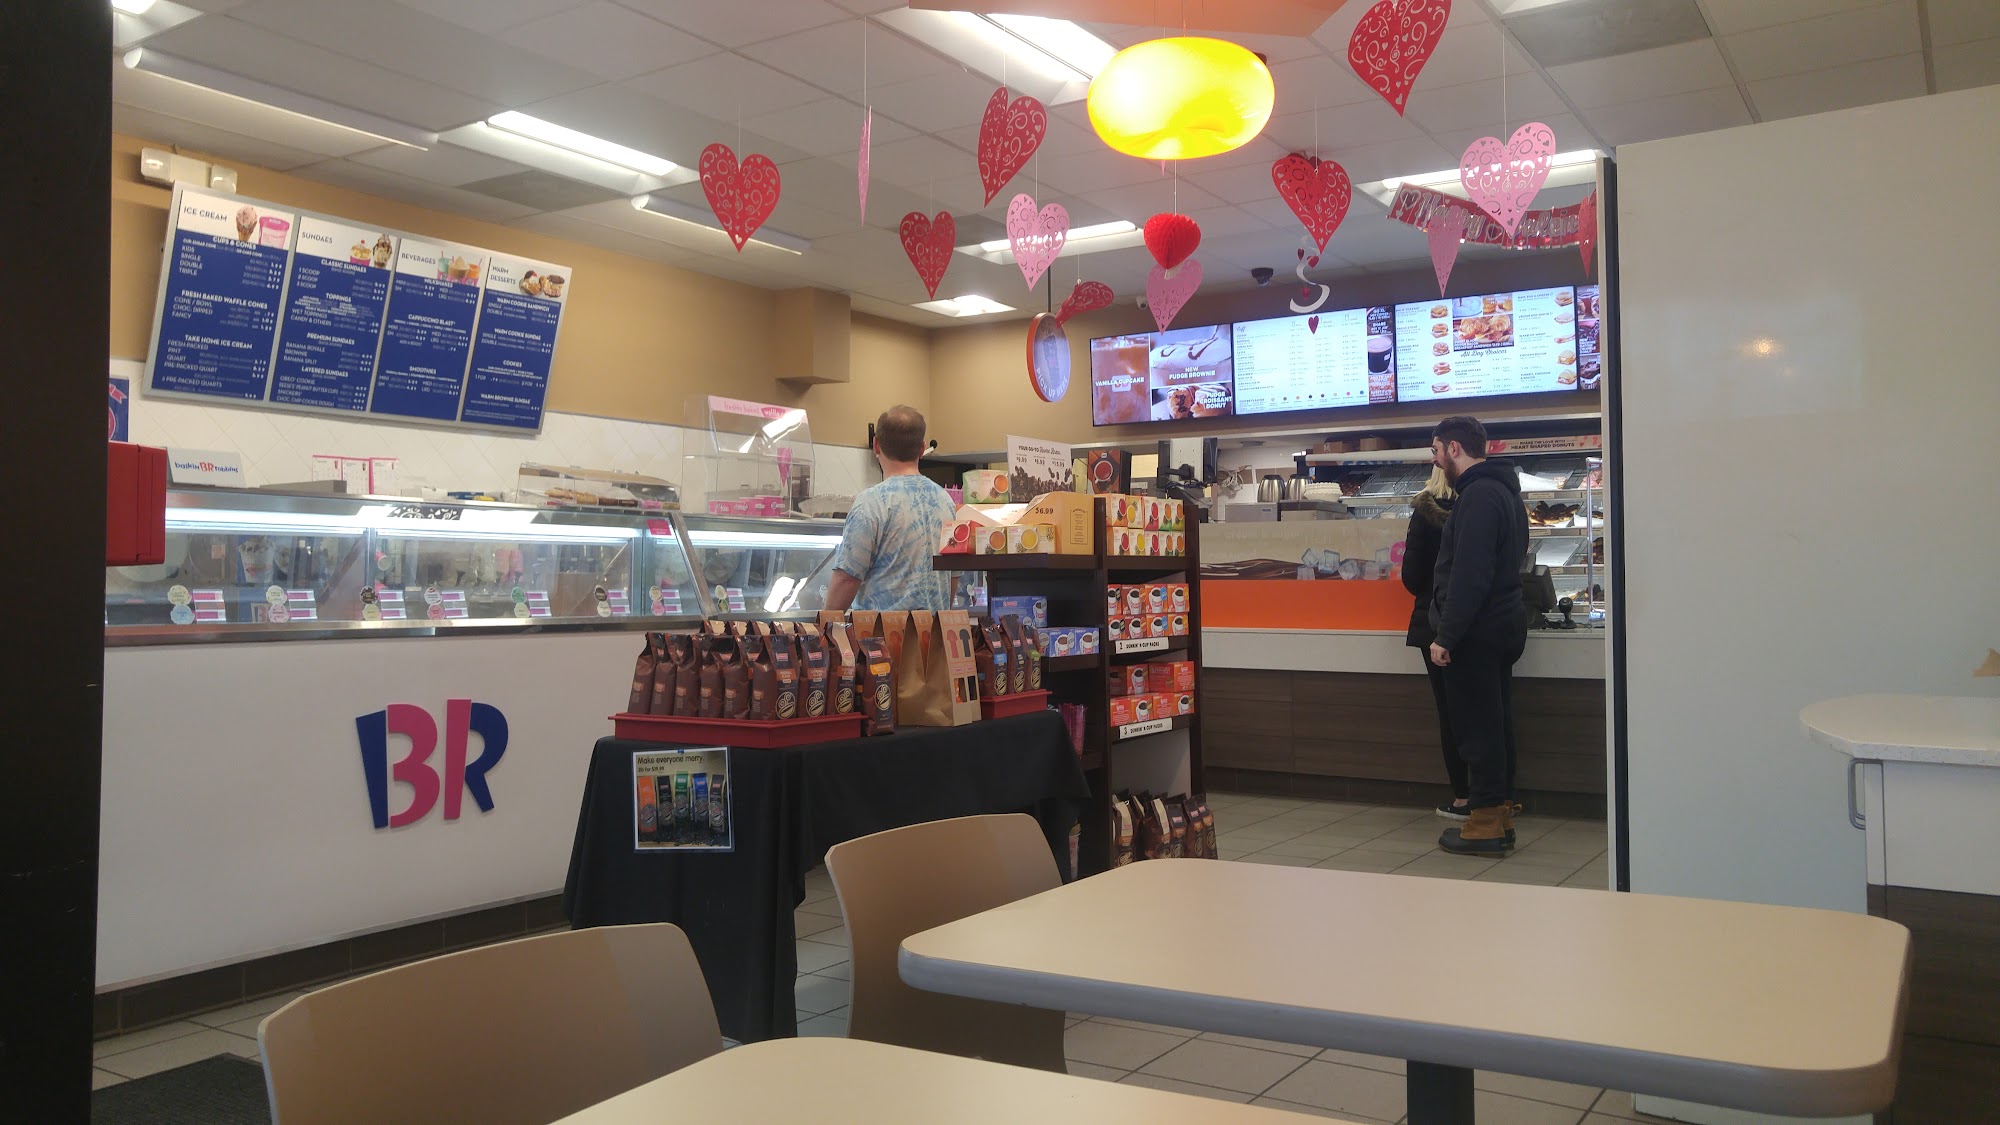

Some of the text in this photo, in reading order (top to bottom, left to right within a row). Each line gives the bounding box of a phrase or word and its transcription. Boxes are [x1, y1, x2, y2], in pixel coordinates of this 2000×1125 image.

[184, 206, 227, 221] ICE CREAM
[302, 232, 332, 244] SUNDAES
[213, 236, 229, 244] CUPS
[236, 241, 256, 250] CONES
[181, 252, 201, 261] SINGLE
[402, 253, 436, 264] BEVERAGES
[180, 260, 202, 269] DOUBLE
[321, 259, 343, 268] CLASSIC
[344, 262, 366, 273] SUNDAES
[179, 267, 197, 276] TRIPLE
[302, 267, 320, 276] SCOOP
[492, 266, 509, 274] WARM
[302, 274, 318, 282] SCOOP
[491, 275, 516, 284] DESSERTS
[424, 279, 453, 288] MILKSHAKES
[182, 289, 268, 309] FRESH BAKED WAFFLE CONES
[326, 293, 351, 302] TOPPINGS
[497, 297, 550, 312] WARM COOKIE SANDWICH
[172, 311, 191, 319] FANCY
[408, 314, 440, 324] CAPPUCCINO
[313, 318, 331, 326] OTHERS
[307, 332, 331, 341] PREMIUM
[332, 336, 355, 345] SUNDAES
[508, 329, 524, 337] COOKIE
[525, 332, 541, 340] SUNDAE
[185, 334, 200, 342] TAKE
[201, 337, 220, 345] HOME
[232, 341, 253, 350] CREAM
[1472, 349, 1484, 357] Day
[302, 366, 325, 374] LAYERED
[326, 369, 348, 377] SUNDAES
[409, 366, 436, 374] SMOOTHIES
[1037, 368, 1048, 393] PICK
[1049, 389, 1056, 398] UP
[515, 397, 530, 405] SUNDAE
[1199, 396, 1232, 404] CROISSANT
[175, 462, 200, 470] baskin
[200, 462, 214, 472] BR
[356, 699, 508, 829] BR
[656, 756, 684, 764] everyone
[685, 755, 705, 763] merry.
